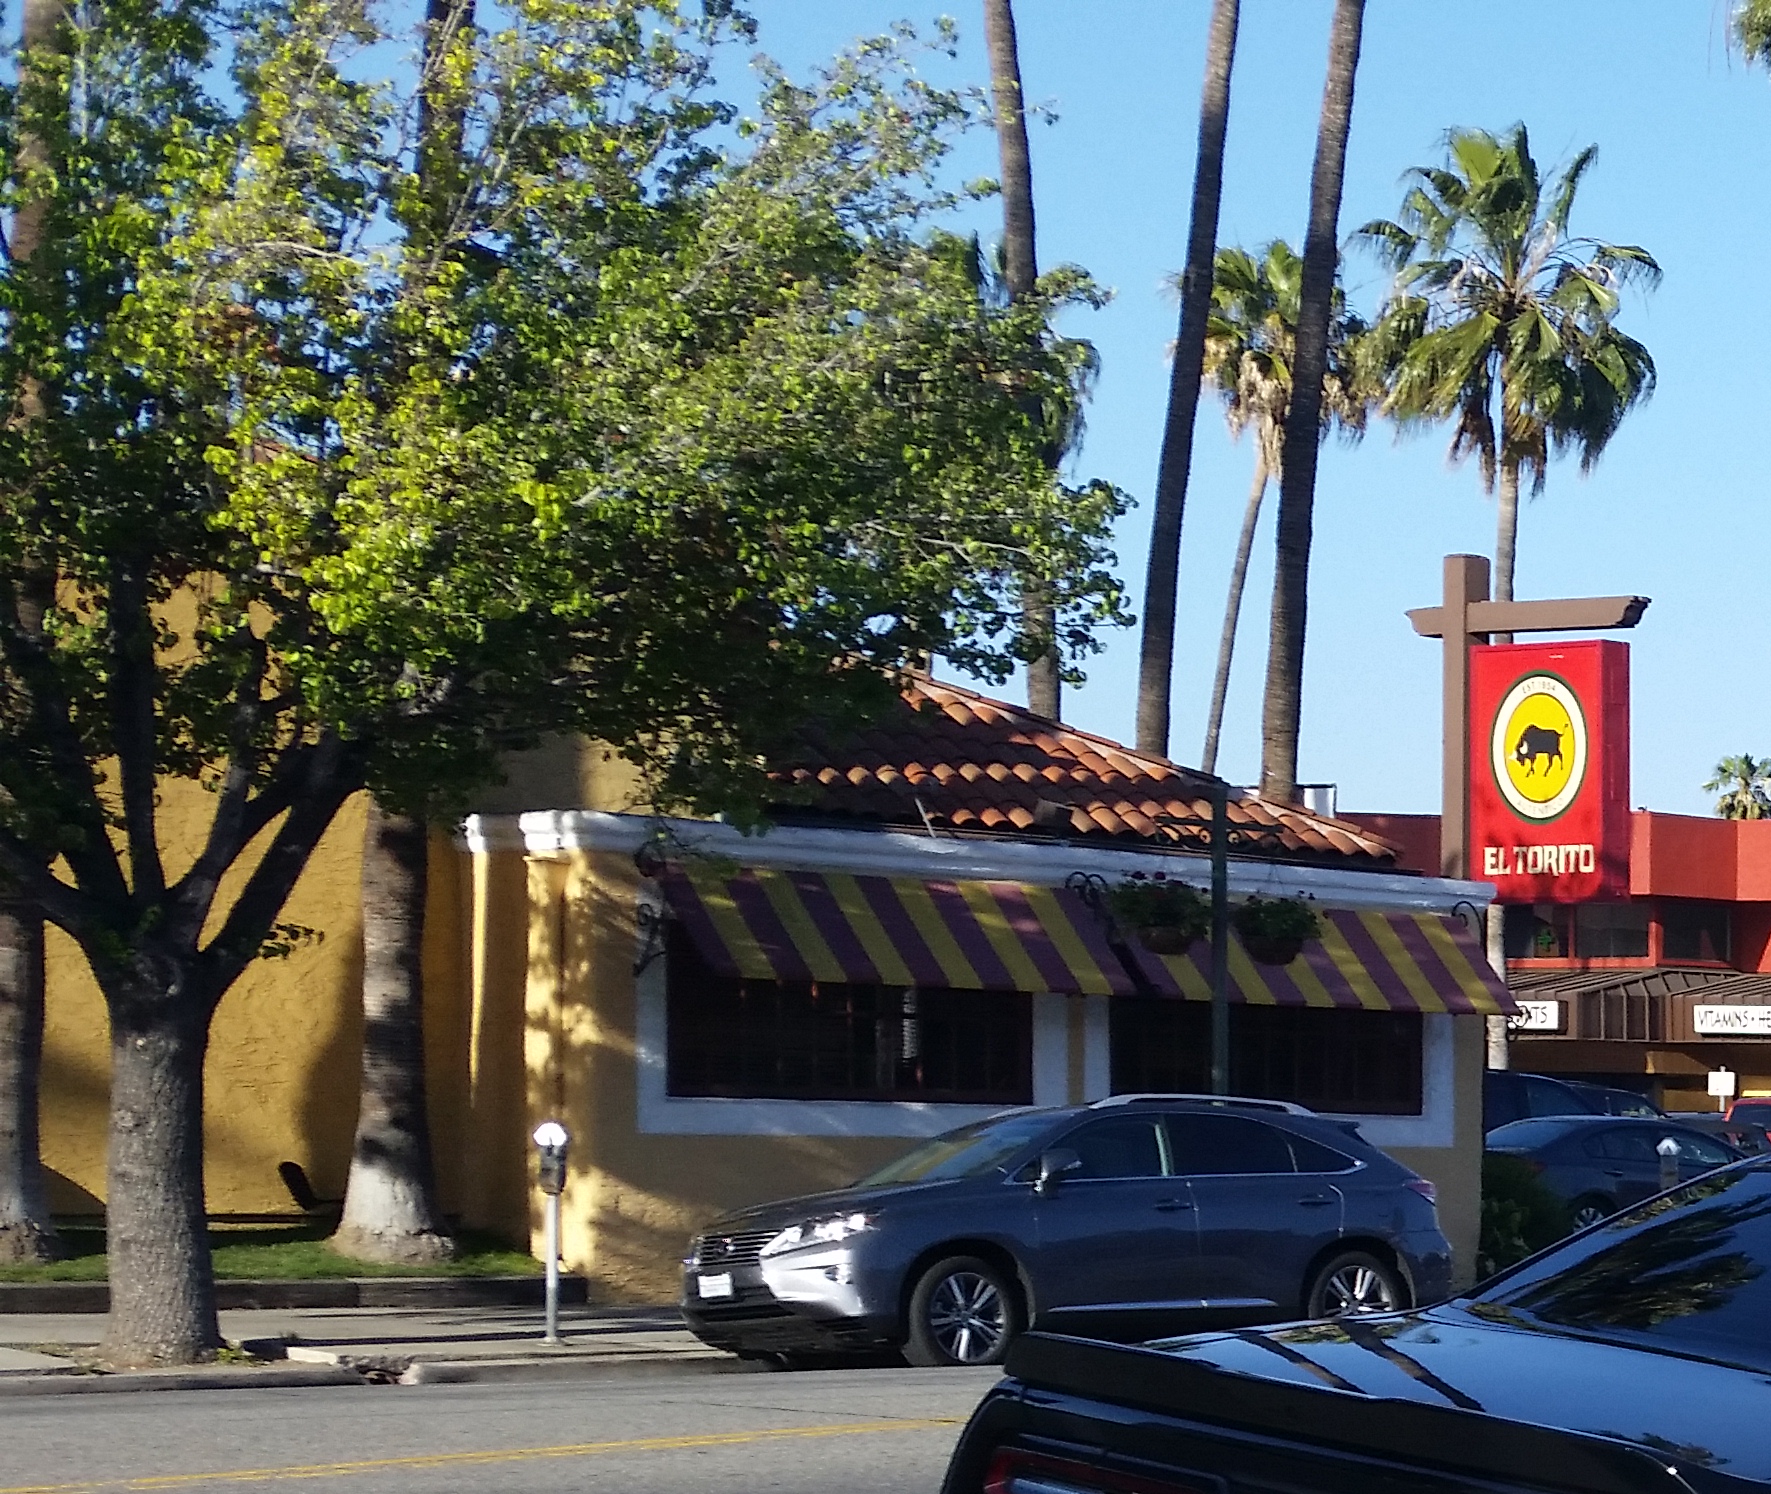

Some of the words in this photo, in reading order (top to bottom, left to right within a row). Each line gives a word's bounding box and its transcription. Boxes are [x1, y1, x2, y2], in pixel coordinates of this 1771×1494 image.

[1483, 846, 1511, 876] EL
[1513, 843, 1596, 877] TORITO
[1697, 1010, 1749, 1029] VITAMINS
